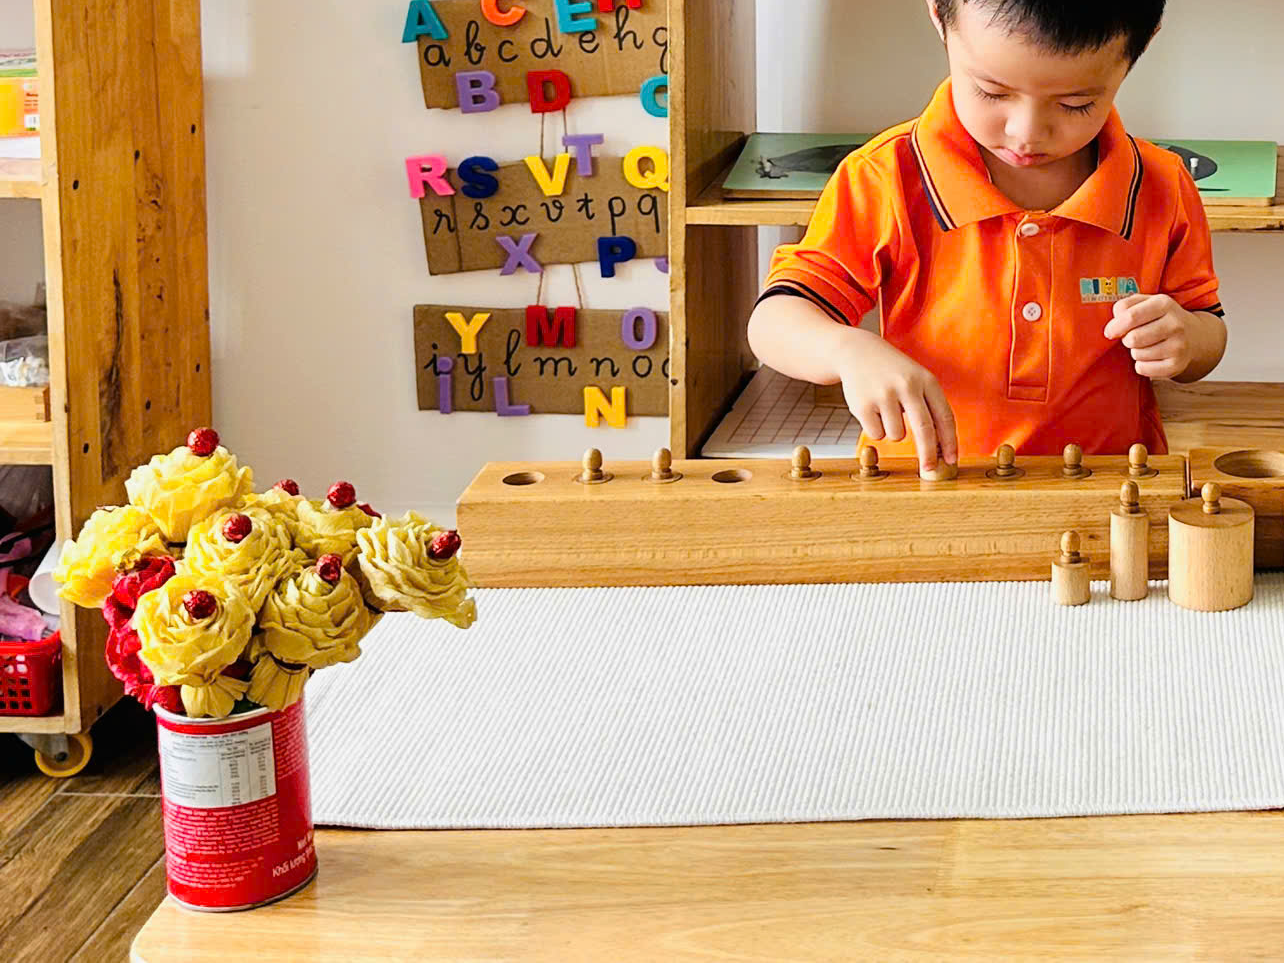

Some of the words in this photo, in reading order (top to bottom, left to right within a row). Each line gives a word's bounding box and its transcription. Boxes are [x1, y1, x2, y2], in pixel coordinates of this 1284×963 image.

[455, 71, 501, 114] B
[527, 69, 571, 114] D
[405, 154, 456, 198] R
[457, 156, 499, 198] S
[524, 153, 571, 197] V
[562, 133, 604, 176] T
[623, 145, 669, 192] Q
[495, 233, 544, 276] X
[597, 236, 637, 278] P
[444, 312, 491, 354] Y
[525, 305, 577, 349] M
[622, 306, 657, 351] O
[493, 376, 531, 417] L
[583, 385, 628, 429] N
